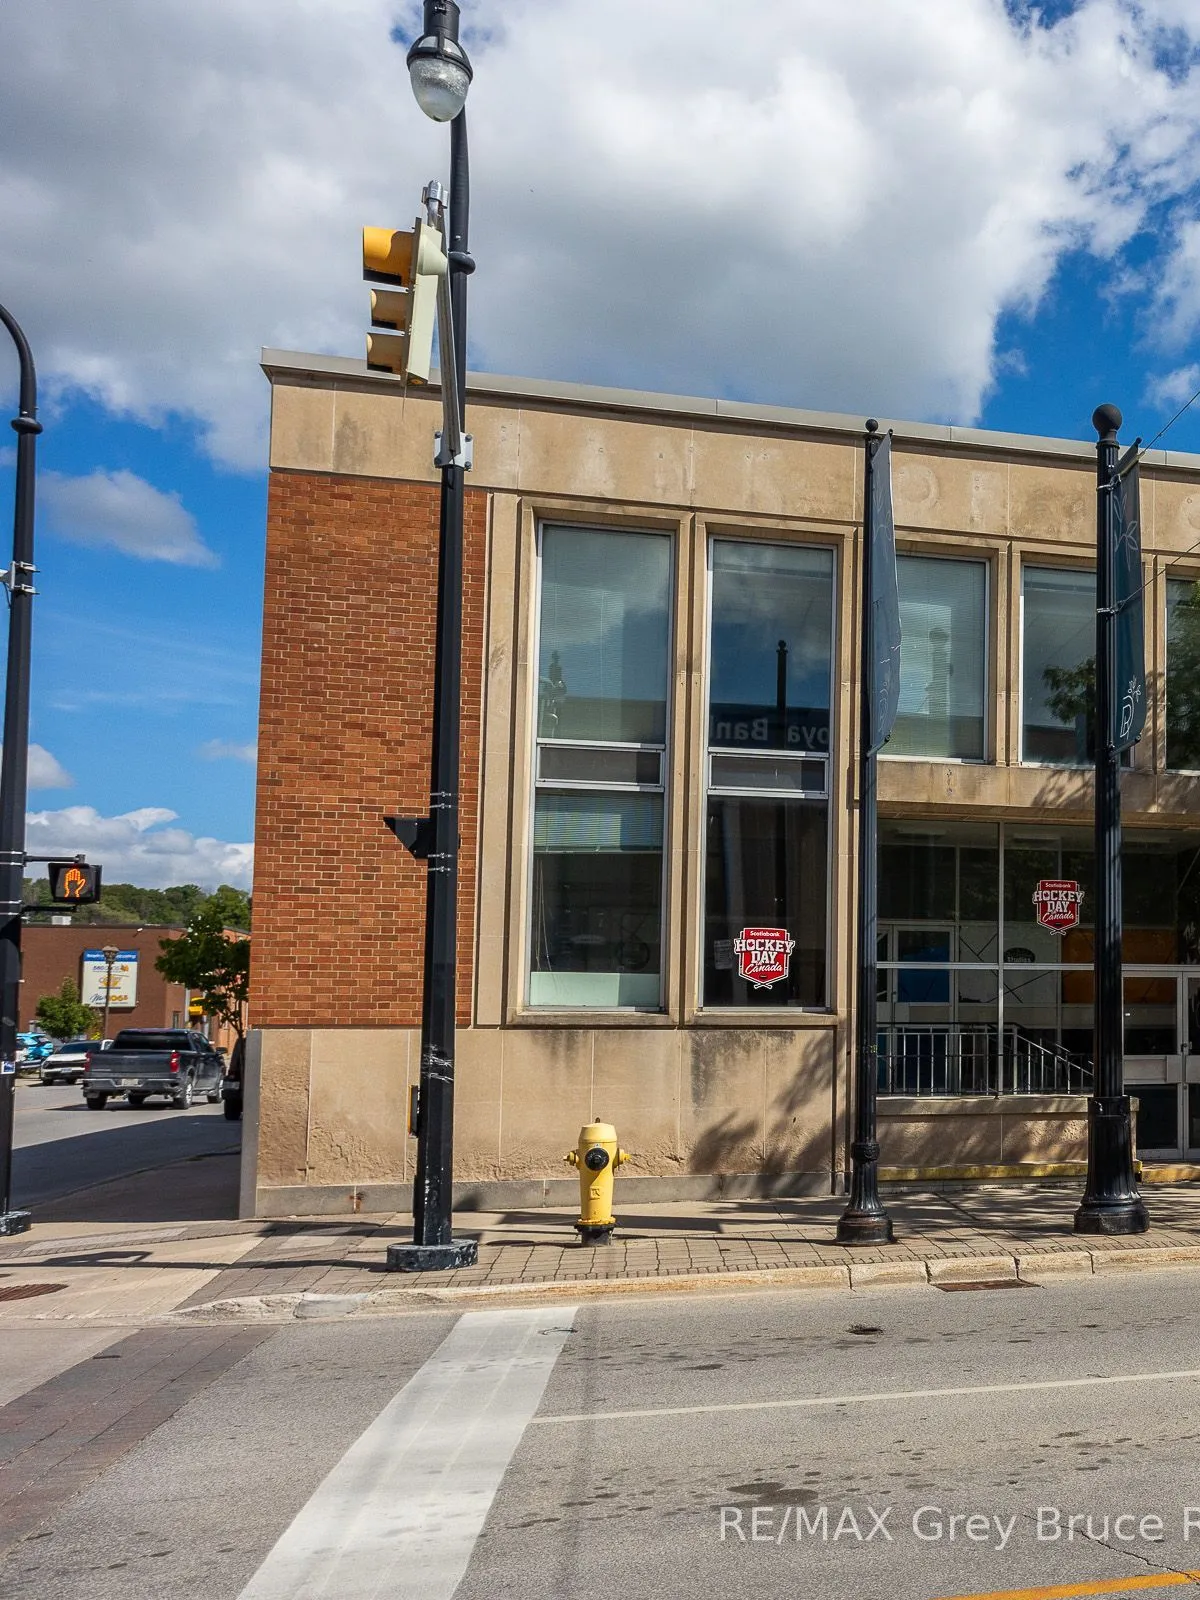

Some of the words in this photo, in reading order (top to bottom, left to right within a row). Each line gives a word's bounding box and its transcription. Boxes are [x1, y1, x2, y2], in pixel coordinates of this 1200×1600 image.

[1033, 890, 1083, 903] HOCKEY
[1047, 901, 1070, 913] DAY
[1042, 911, 1075, 923] Canada
[750, 930, 780, 938] Scotiabank
[735, 939, 794, 954] HOCKEY
[751, 951, 778, 964] DAY
[745, 962, 783, 975] Canada
